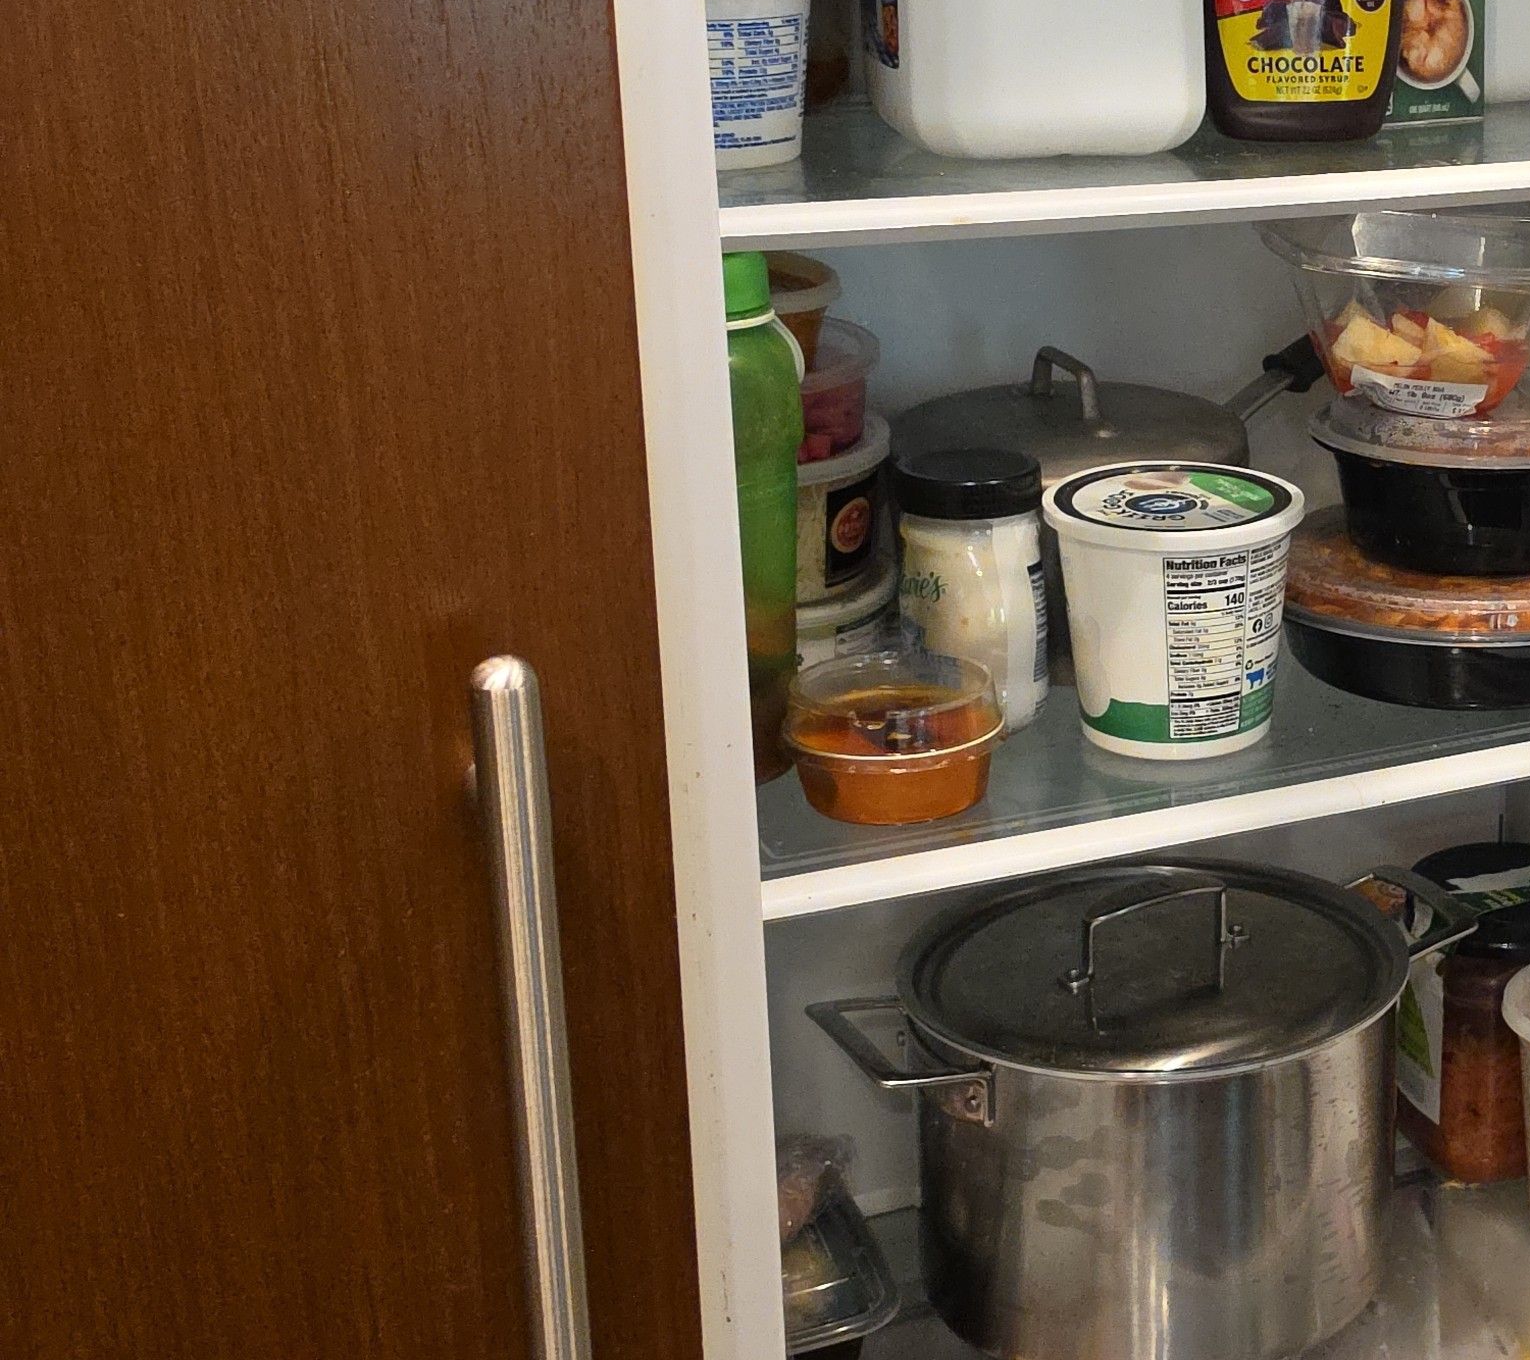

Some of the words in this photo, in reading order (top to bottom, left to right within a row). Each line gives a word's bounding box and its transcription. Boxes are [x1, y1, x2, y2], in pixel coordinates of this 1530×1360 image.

[1247, 56, 1365, 74] CHOCOLATE
[1266, 75, 1318, 84] FLAVORED
[1318, 74, 1350, 84] SYRUP
[1166, 560, 1218, 571] Nutrition
[1219, 555, 1247, 568] Facts
[1167, 601, 1208, 611] Calories
[1224, 592, 1245, 606] 140
